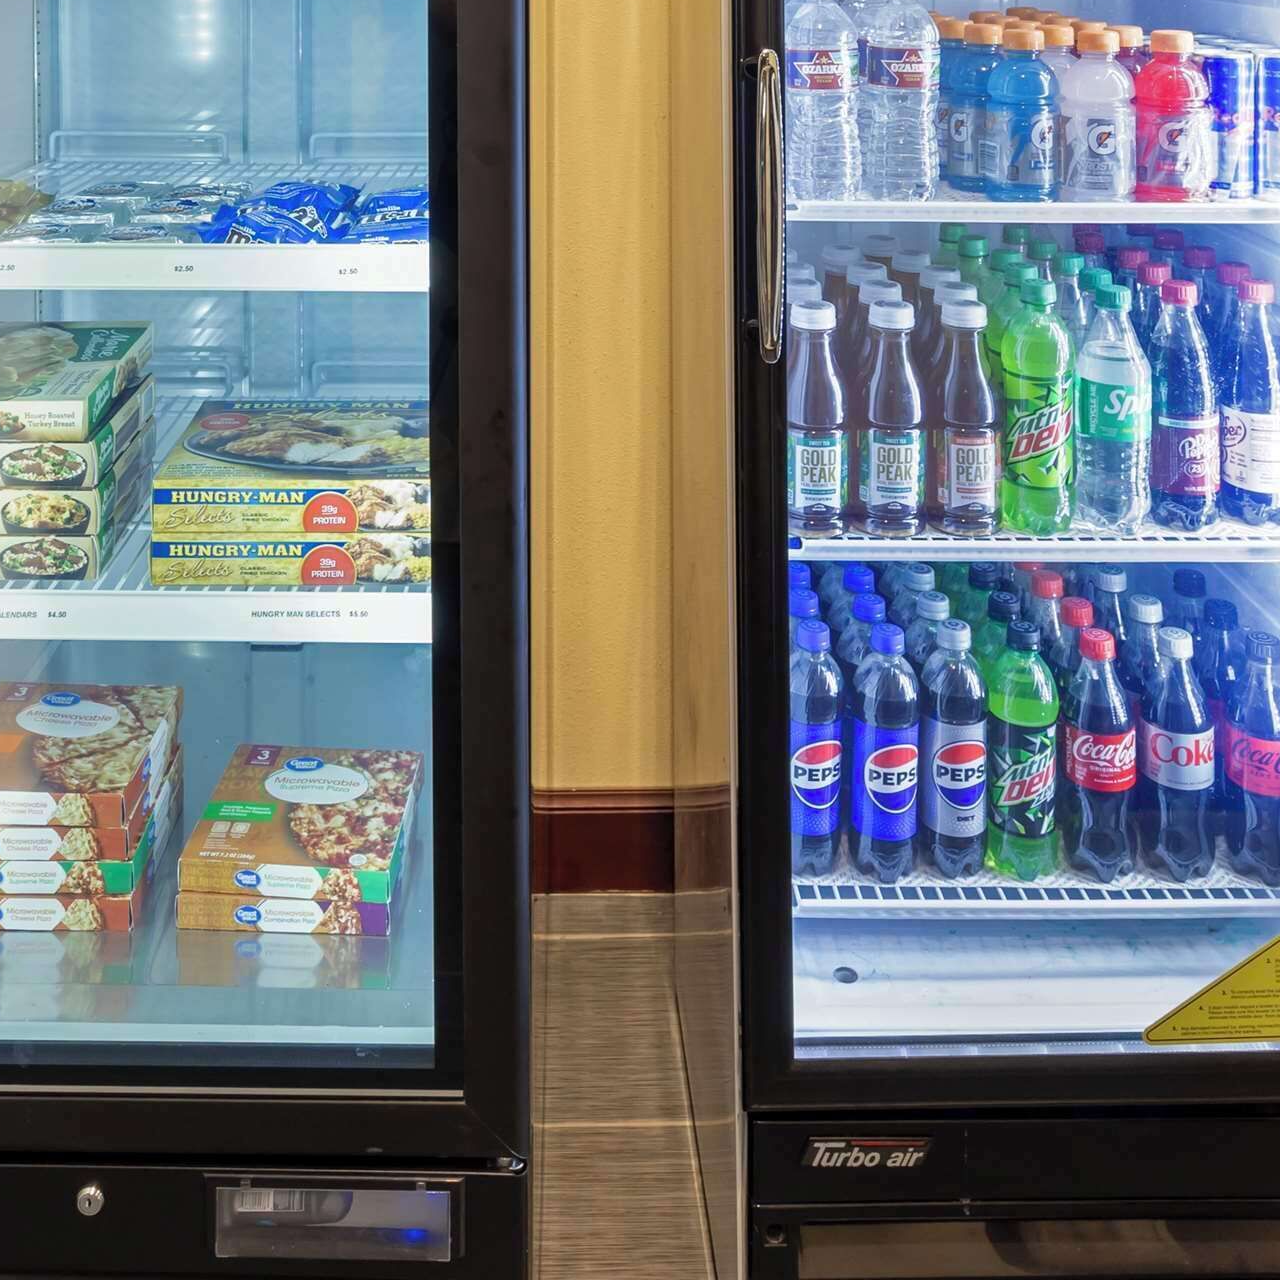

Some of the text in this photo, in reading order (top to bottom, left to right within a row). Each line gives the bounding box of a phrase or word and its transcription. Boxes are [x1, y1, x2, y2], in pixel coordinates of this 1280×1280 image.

[802, 64, 844, 74] OZARK
[890, 62, 932, 72] OZAR
[338, 268, 358, 276] $2.50
[232, 401, 410, 410] HUNGRY-MAN
[24, 412, 76, 420] Honey Roasted
[28, 420, 76, 428] Turkey Breast
[800, 449, 836, 464] GOLD
[876, 448, 912, 464] GOLD
[800, 466, 836, 483] PEAK
[876, 464, 912, 481] PEAK
[171, 491, 305, 504] HUNGRY-MAN
[164, 504, 236, 528] Selects
[312, 516, 346, 525] PROTEIN
[169, 544, 303, 556] HUNGRY-MAN
[319, 558, 336, 568] 39g
[162, 558, 234, 582] Selects
[311, 570, 344, 578] PROTEIN
[251, 610, 285, 618] HUNGRY
[286, 610, 304, 618] MAN
[305, 610, 341, 618] SELECTS
[14, 687, 28, 696] 3
[28, 710, 112, 722] Microwavable
[1072, 730, 1136, 767] Coca-Co
[1151, 732, 1214, 768] Coke
[256, 750, 270, 760] 3
[794, 764, 840, 782] PEPS
[869, 767, 917, 786] PEPS
[936, 764, 984, 782] PEPS
[274, 776, 360, 788] Microwavable
[2, 838, 52, 847] Microwavable
[812, 1140, 924, 1168] Turbo air
